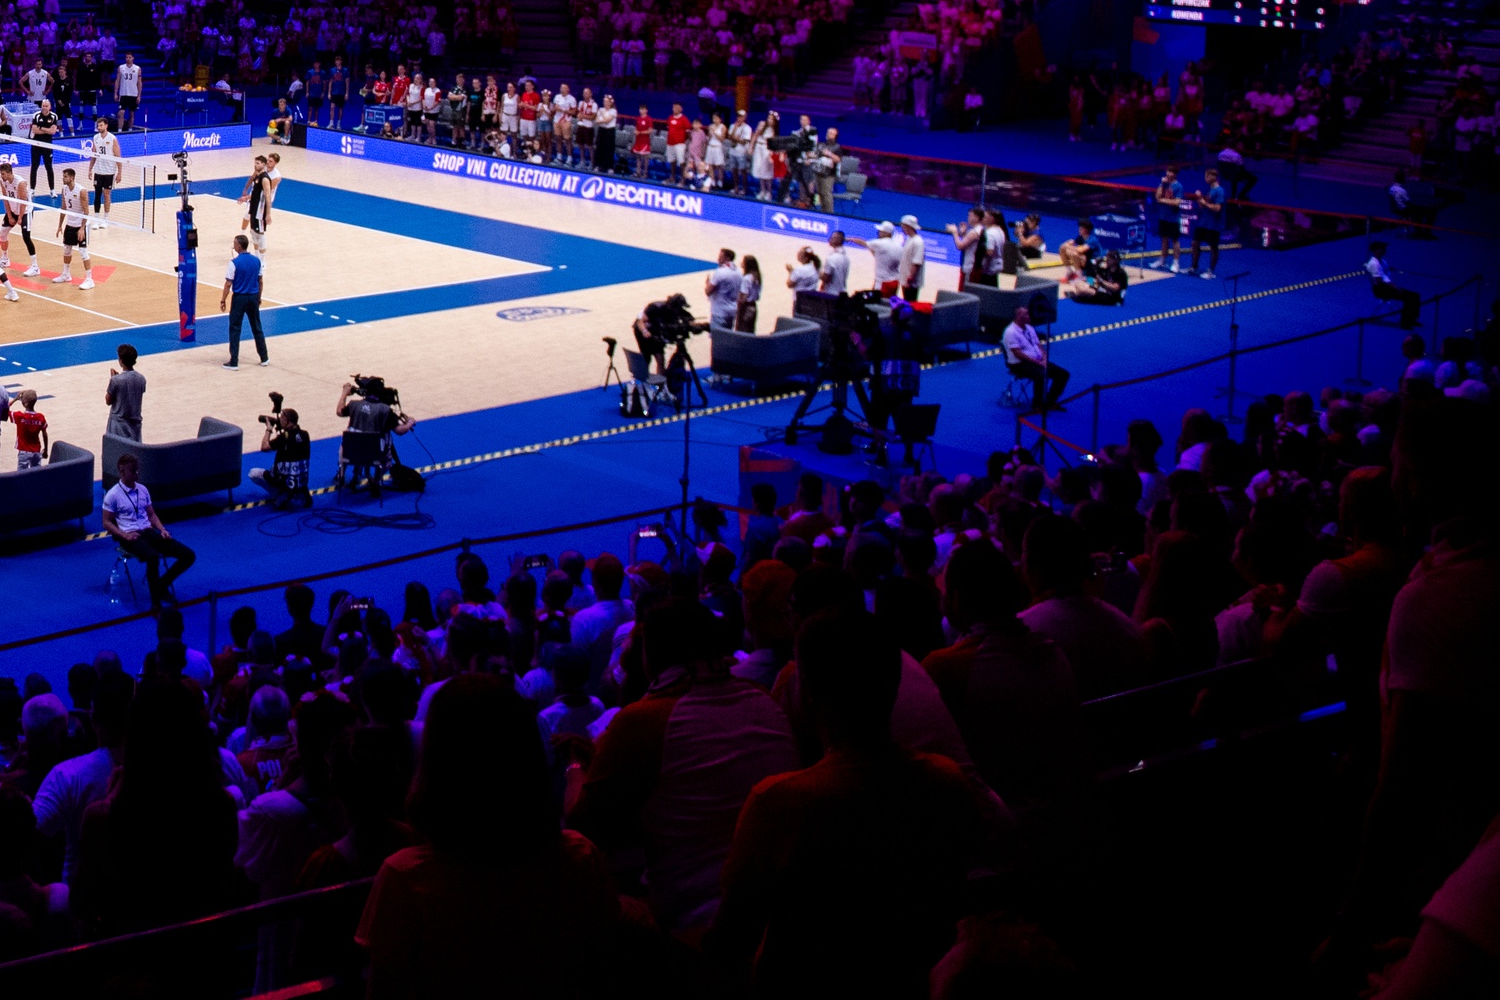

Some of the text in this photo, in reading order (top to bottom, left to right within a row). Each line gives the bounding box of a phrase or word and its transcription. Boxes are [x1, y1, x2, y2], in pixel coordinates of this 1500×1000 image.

[124, 73, 133, 81] 33
[35, 78, 43, 87] 16
[183, 131, 221, 149] Maczfit
[99, 146, 107, 155] 31
[433, 152, 702, 216] SHOP VNL COLLECTION AT DECATHLON
[791, 219, 829, 234] ORLEN
[20, 418, 43, 427] POLSKA
